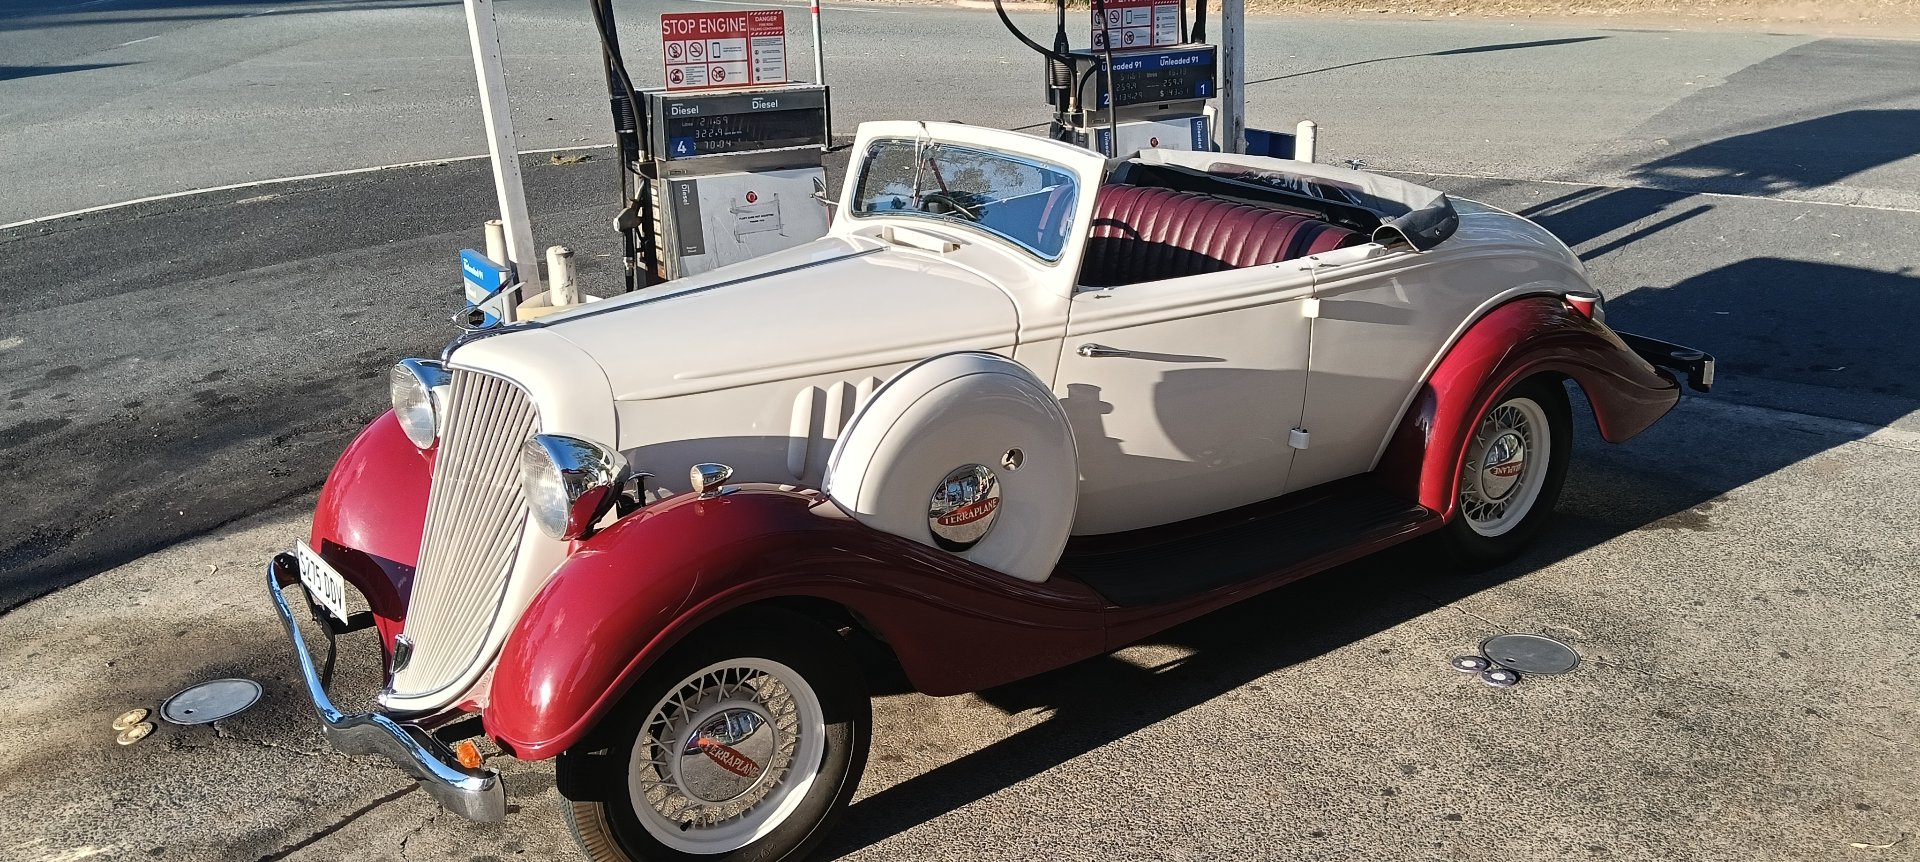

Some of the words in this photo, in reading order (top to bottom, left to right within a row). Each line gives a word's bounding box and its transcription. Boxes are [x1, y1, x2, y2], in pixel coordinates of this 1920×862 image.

[663, 19, 696, 35] STOP
[699, 17, 747, 33] ENGINE
[1102, 61, 1133, 71] Ueaded
[1160, 57, 1191, 66] Unleaded
[1200, 84, 1205, 95] 1
[752, 99, 778, 109] Diesel
[1103, 93, 1110, 104] 2
[671, 105, 699, 115] Diesel
[700, 116, 728, 126] 21.69
[695, 129, 723, 138] 322.9
[677, 140, 687, 154] 4
[704, 140, 731, 149] 70.04
[681, 184, 690, 206] Diesel
[945, 498, 997, 525] TERRAPLANE
[299, 551, 322, 592] S275
[705, 742, 760, 778] TERRAPLANE
